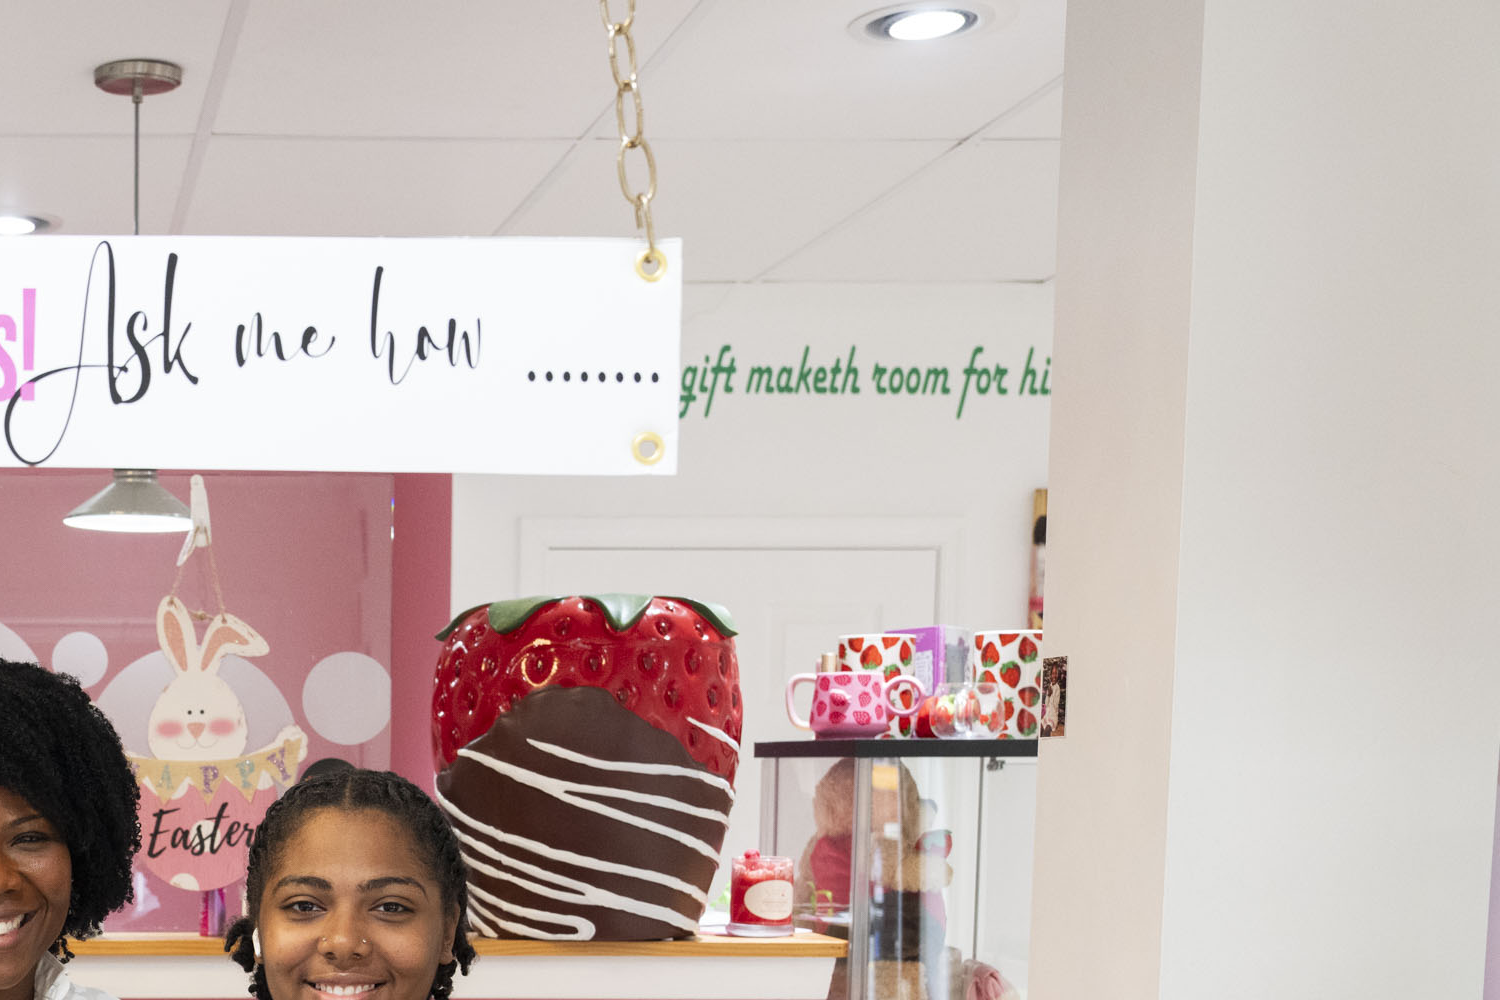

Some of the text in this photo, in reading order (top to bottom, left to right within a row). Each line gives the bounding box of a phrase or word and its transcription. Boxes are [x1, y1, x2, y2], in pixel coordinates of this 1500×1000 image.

[4, 241, 199, 466] Ask
[235, 312, 335, 369] me
[371, 266, 482, 386] how
[679, 344, 1052, 420] gift maketh room for hi
[131, 748, 291, 794] APPY
[147, 802, 256, 859] Easter
